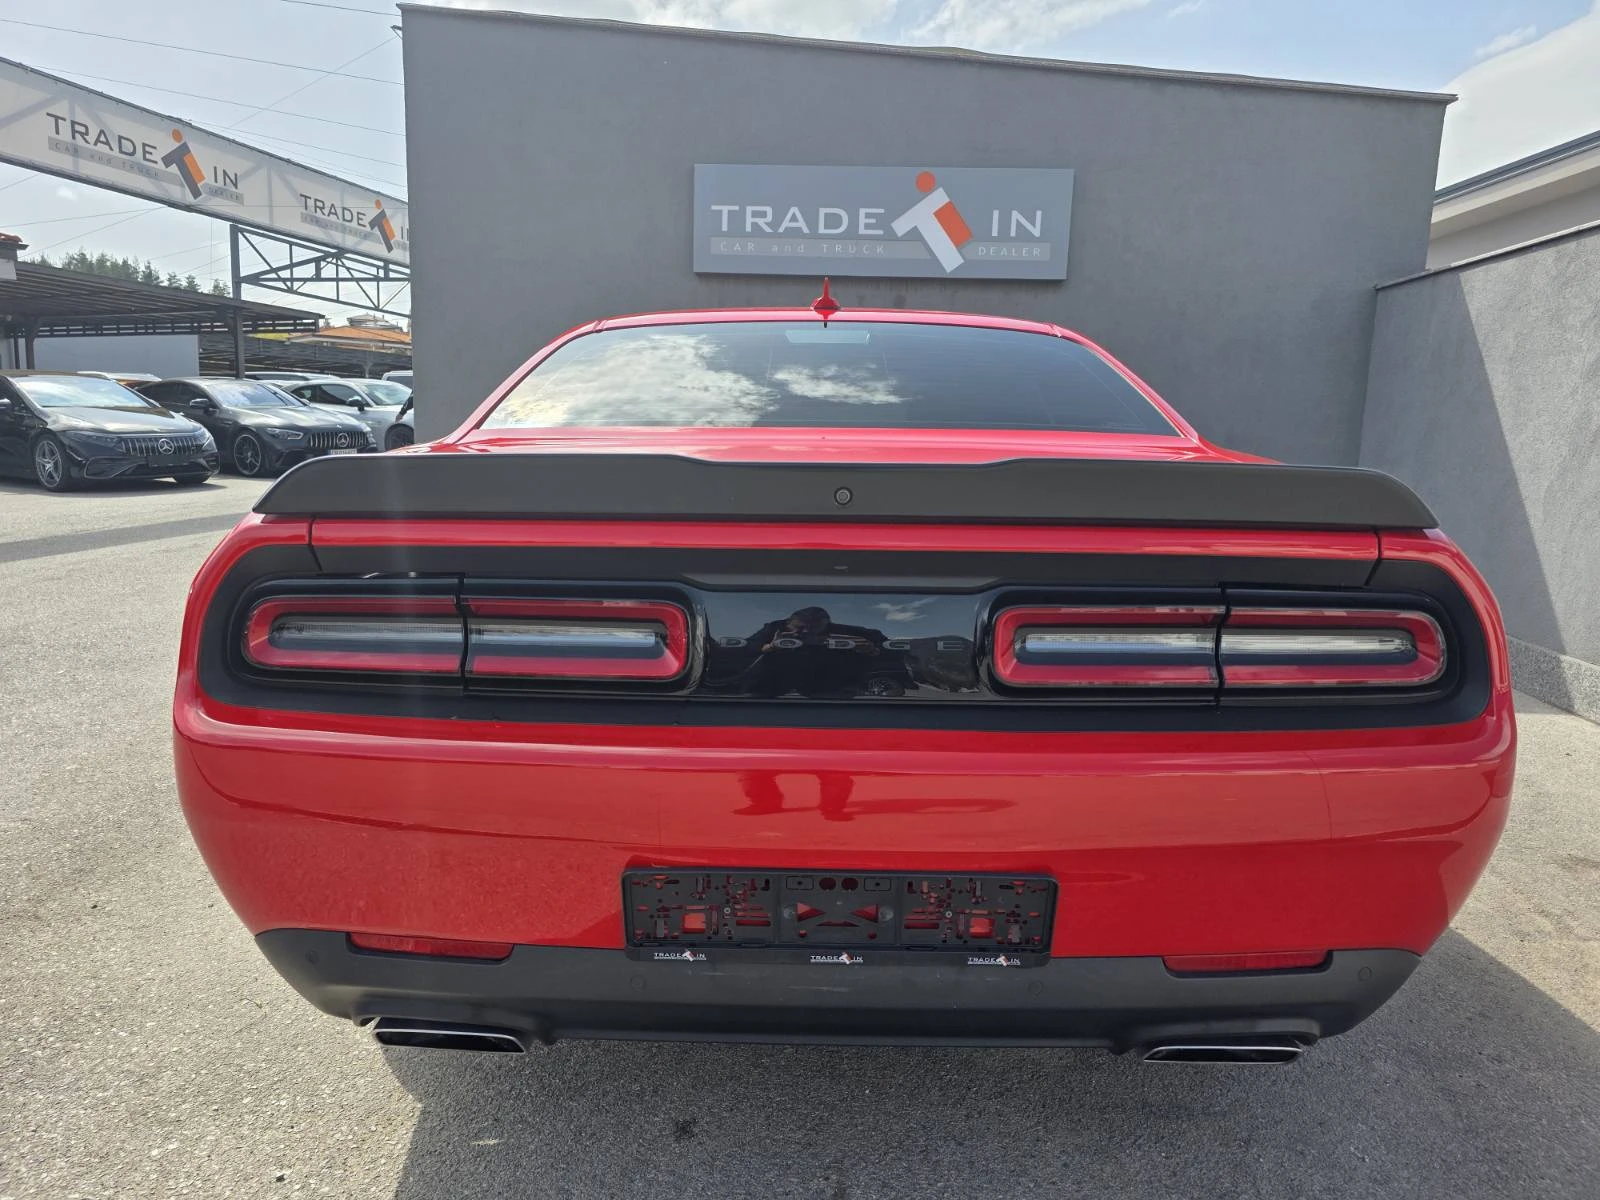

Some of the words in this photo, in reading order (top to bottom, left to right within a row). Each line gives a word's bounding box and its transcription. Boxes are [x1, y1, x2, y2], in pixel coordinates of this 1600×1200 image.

[46, 112, 159, 165] TRADE
[213, 165, 239, 190] IN
[299, 193, 368, 229] TRADE
[711, 205, 885, 235] TRADE
[991, 209, 1042, 238] IN
[720, 242, 755, 252] CAR
[771, 243, 805, 253] and
[822, 244, 885, 255] TRUCK
[978, 246, 1041, 257] DEALER
[720, 637, 963, 651] DODGE
